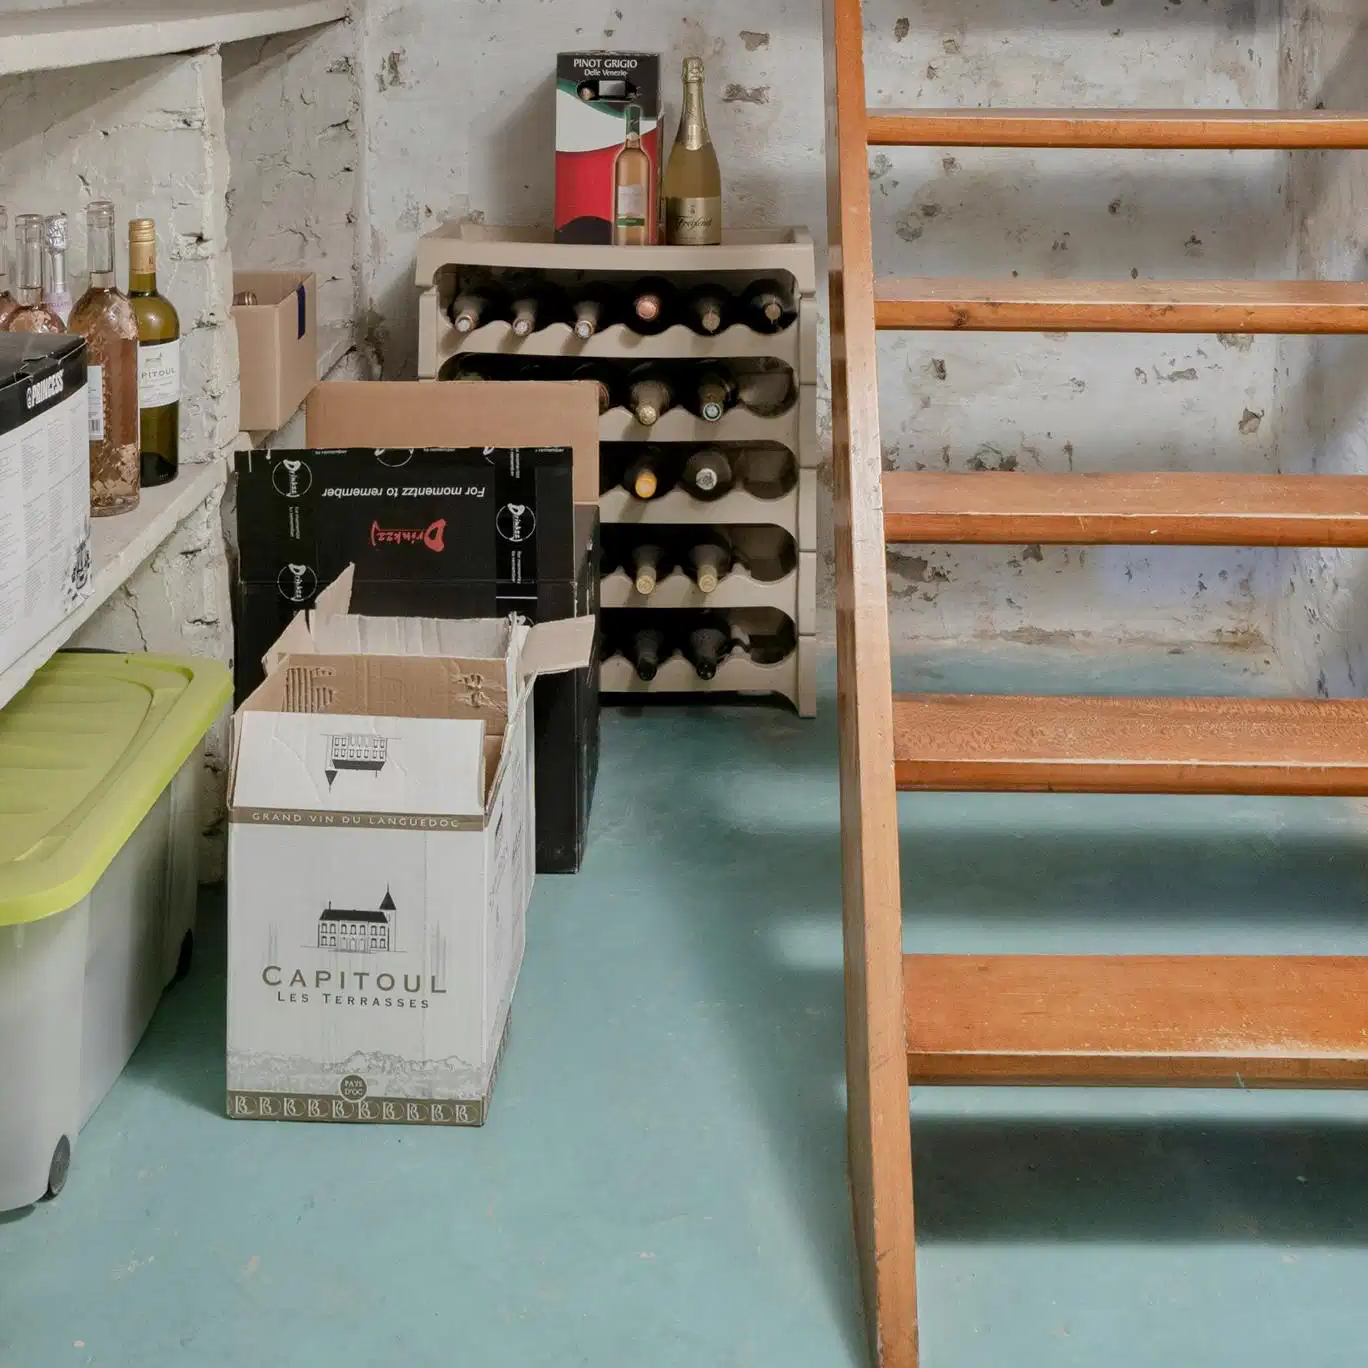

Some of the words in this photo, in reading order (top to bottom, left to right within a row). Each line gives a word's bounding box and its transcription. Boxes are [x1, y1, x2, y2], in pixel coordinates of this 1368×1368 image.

[574, 59, 602, 68] PINOT
[604, 59, 638, 69] GRIGIO
[322, 486, 384, 499] remember
[386, 486, 400, 497] to
[402, 486, 463, 498] momentzz
[466, 486, 486, 498] For
[252, 812, 302, 823] GRAND
[310, 815, 334, 824] VIN
[342, 816, 361, 825] DU
[369, 816, 460, 828] LANGUEDOC
[262, 965, 447, 994] CAPITOUL
[277, 991, 309, 1003] LES
[322, 993, 429, 1009] TERRASSES
